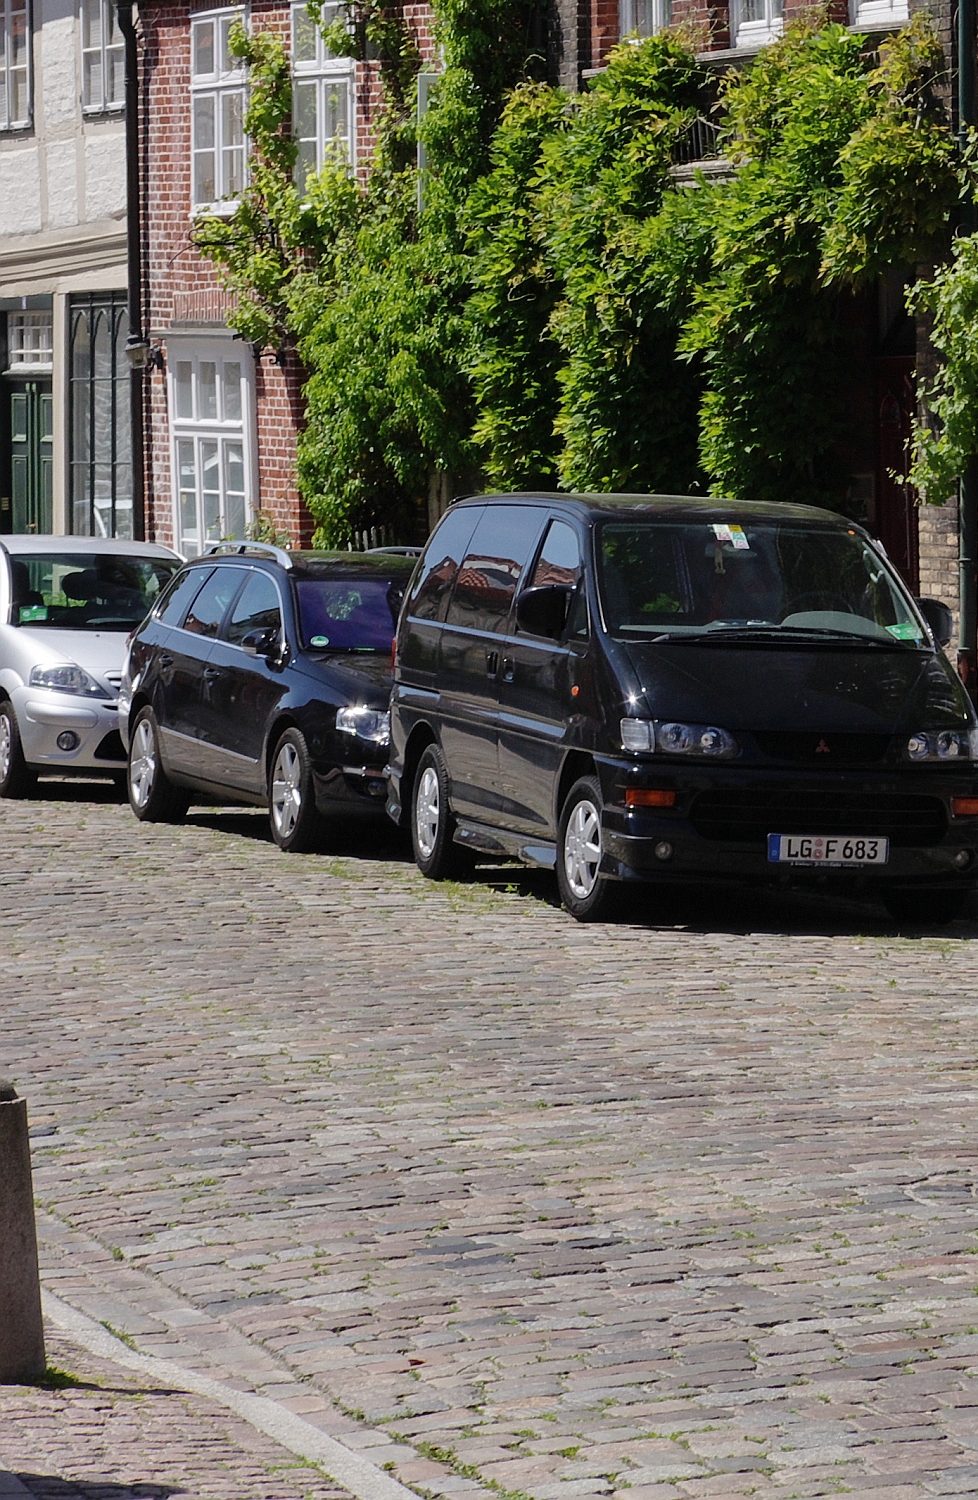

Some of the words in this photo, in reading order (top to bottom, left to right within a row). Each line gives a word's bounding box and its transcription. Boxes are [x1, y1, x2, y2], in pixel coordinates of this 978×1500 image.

[788, 839, 812, 858] LG
[826, 840, 838, 858] F
[842, 840, 878, 860] 683
